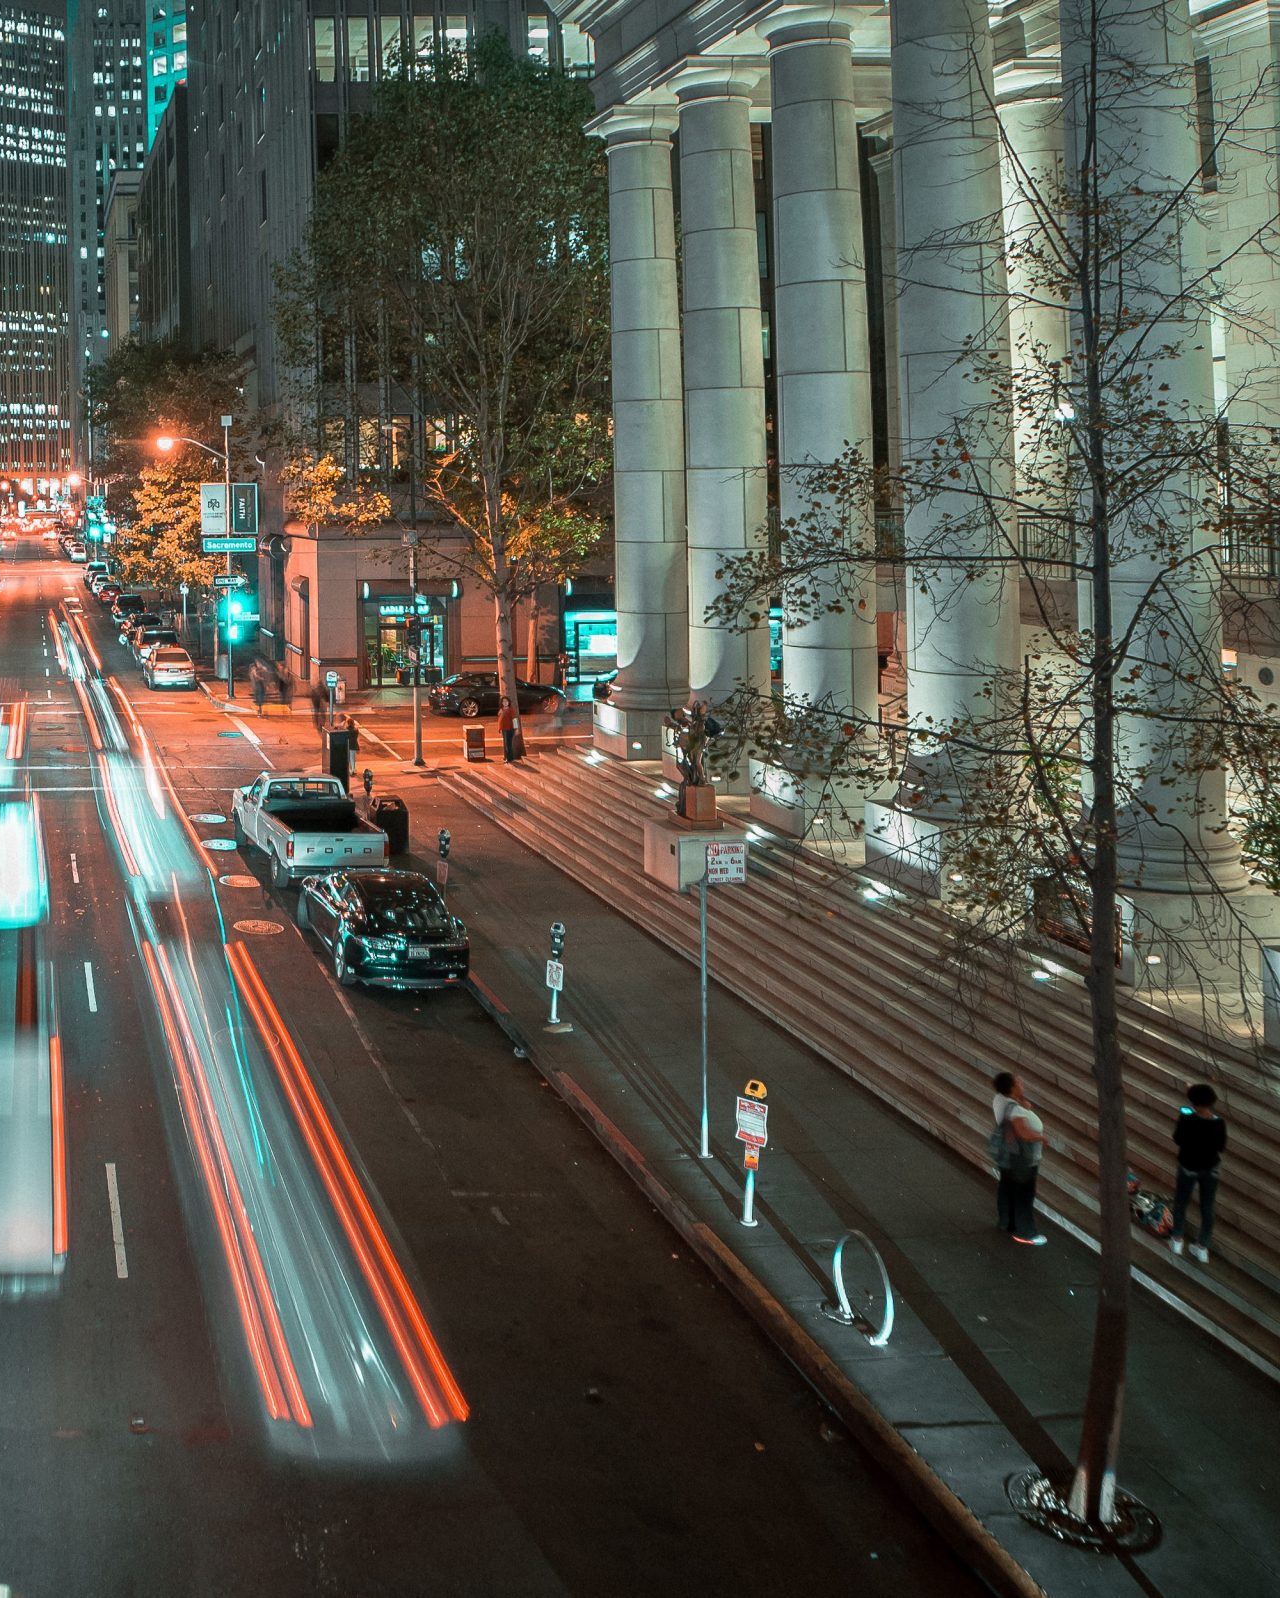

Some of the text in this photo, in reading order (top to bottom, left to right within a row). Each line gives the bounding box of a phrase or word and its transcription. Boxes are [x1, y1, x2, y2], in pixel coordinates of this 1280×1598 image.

[206, 541, 252, 549] Sacramento
[380, 605, 404, 615] LADLE
[708, 844, 743, 855] NO PARKING
